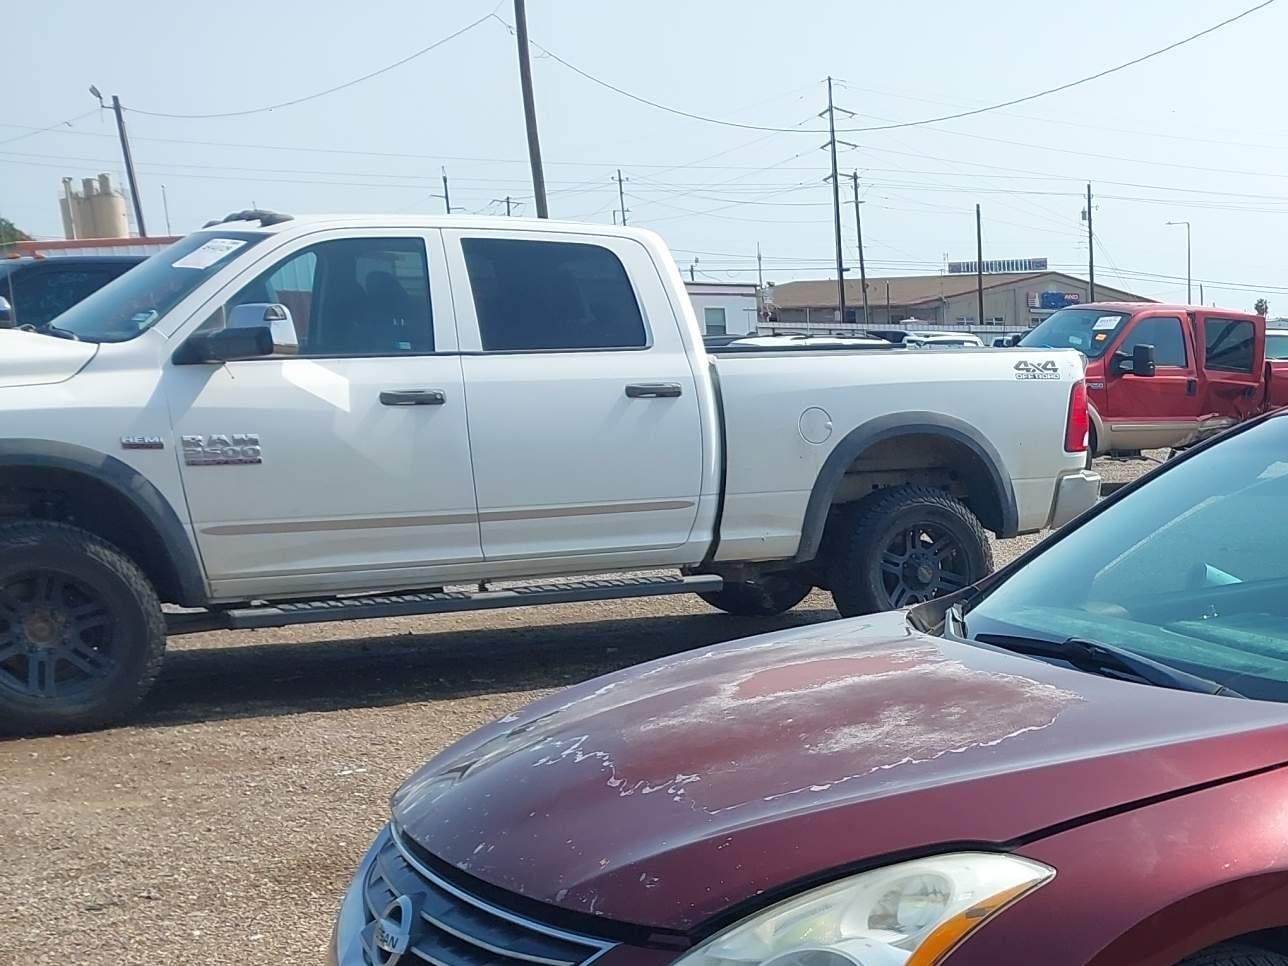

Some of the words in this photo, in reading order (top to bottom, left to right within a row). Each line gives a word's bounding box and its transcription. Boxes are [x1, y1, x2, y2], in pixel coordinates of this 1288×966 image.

[121, 435, 164, 444] HEMI
[181, 433, 261, 447] RAM
[184, 446, 262, 459] 2500
